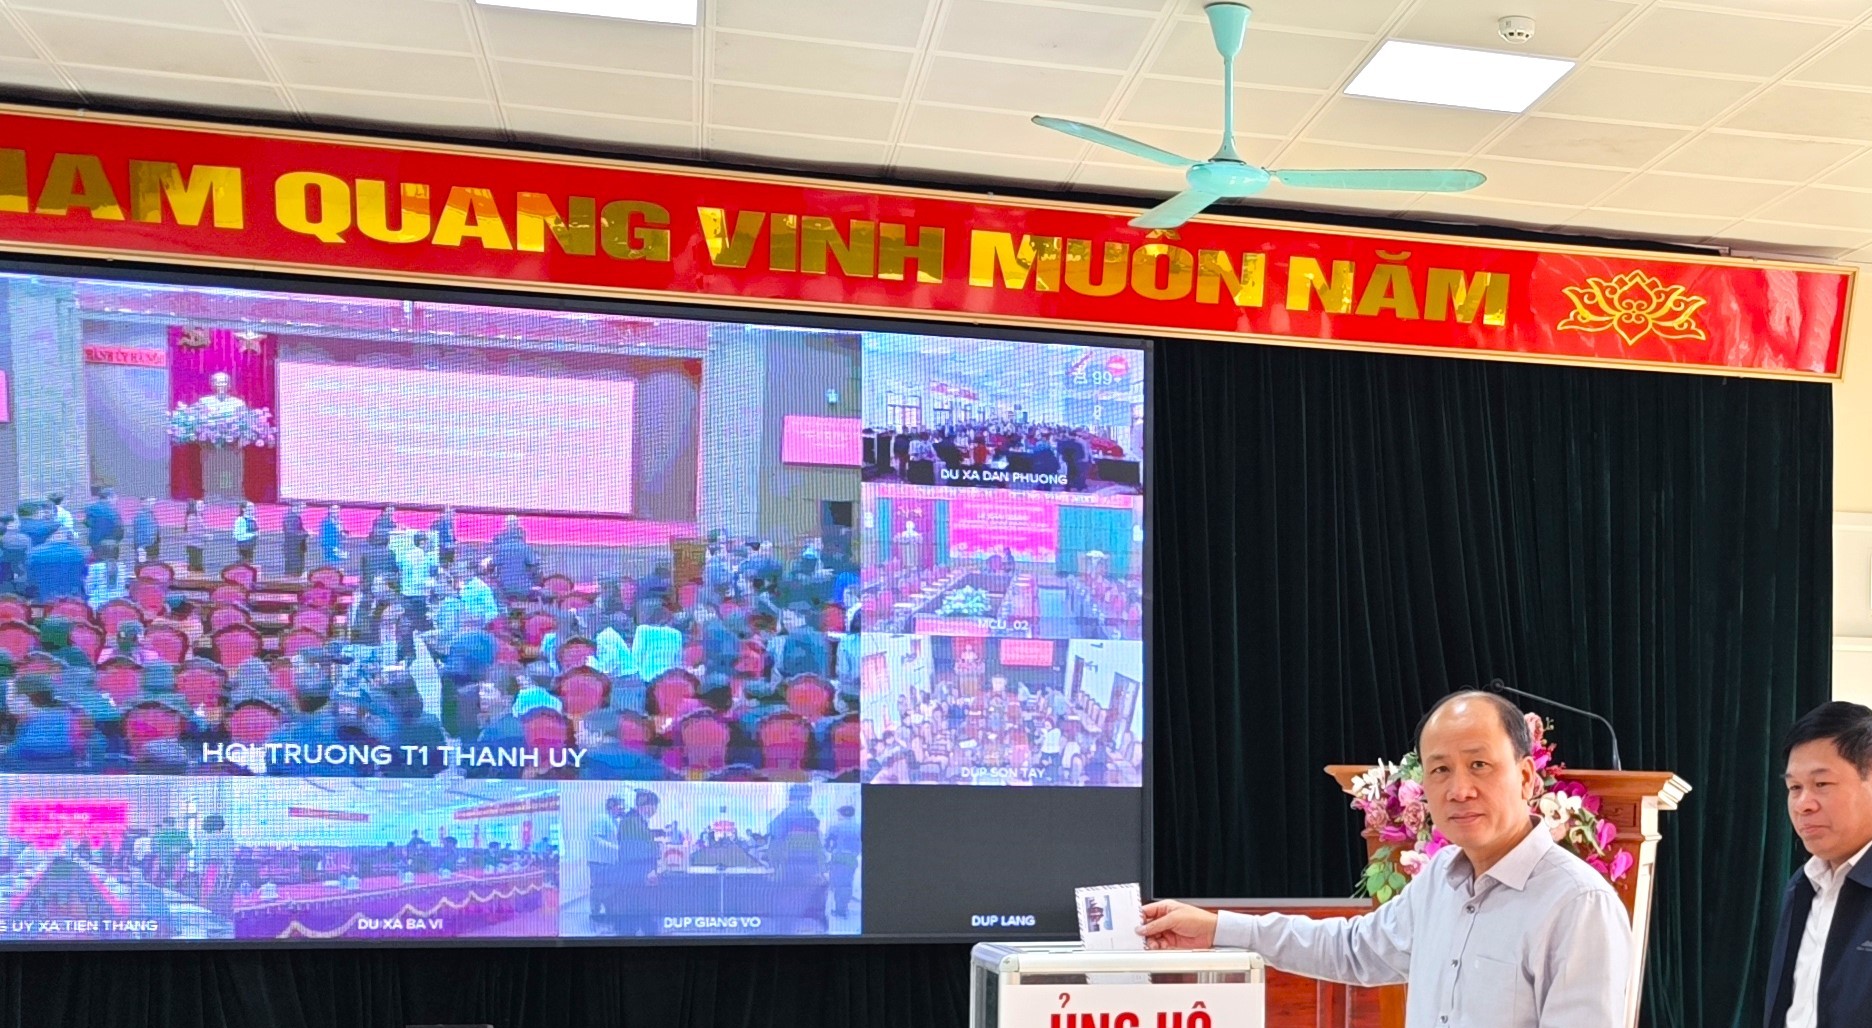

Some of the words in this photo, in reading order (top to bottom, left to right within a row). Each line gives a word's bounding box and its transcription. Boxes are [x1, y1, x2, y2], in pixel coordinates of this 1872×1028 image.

[275, 172, 670, 261] QUANG
[698, 207, 942, 283] VINH
[969, 228, 1266, 308] MUÔN
[1286, 247, 1510, 327] NĂM
[941, 468, 959, 480] DU
[962, 469, 980, 481] XA
[983, 470, 1010, 483] DAN
[1012, 472, 1068, 485] PHUONG
[264, 742, 392, 766] TRUONG
[400, 745, 430, 766] T1
[438, 745, 540, 768] THANH
[548, 747, 588, 769] UY
[1020, 767, 1046, 779] TAY
[12, 920, 34, 932] UY
[66, 920, 98, 931] TIEN
[102, 920, 158, 931] THANG
[358, 918, 379, 930] DU
[406, 918, 426, 930] BA
[427, 918, 443, 930] VI
[664, 917, 692, 928] DUP
[695, 917, 737, 928] GIANG
[741, 917, 761, 928] VO
[971, 915, 999, 927] DUP
[1001, 914, 1036, 926] LANG
